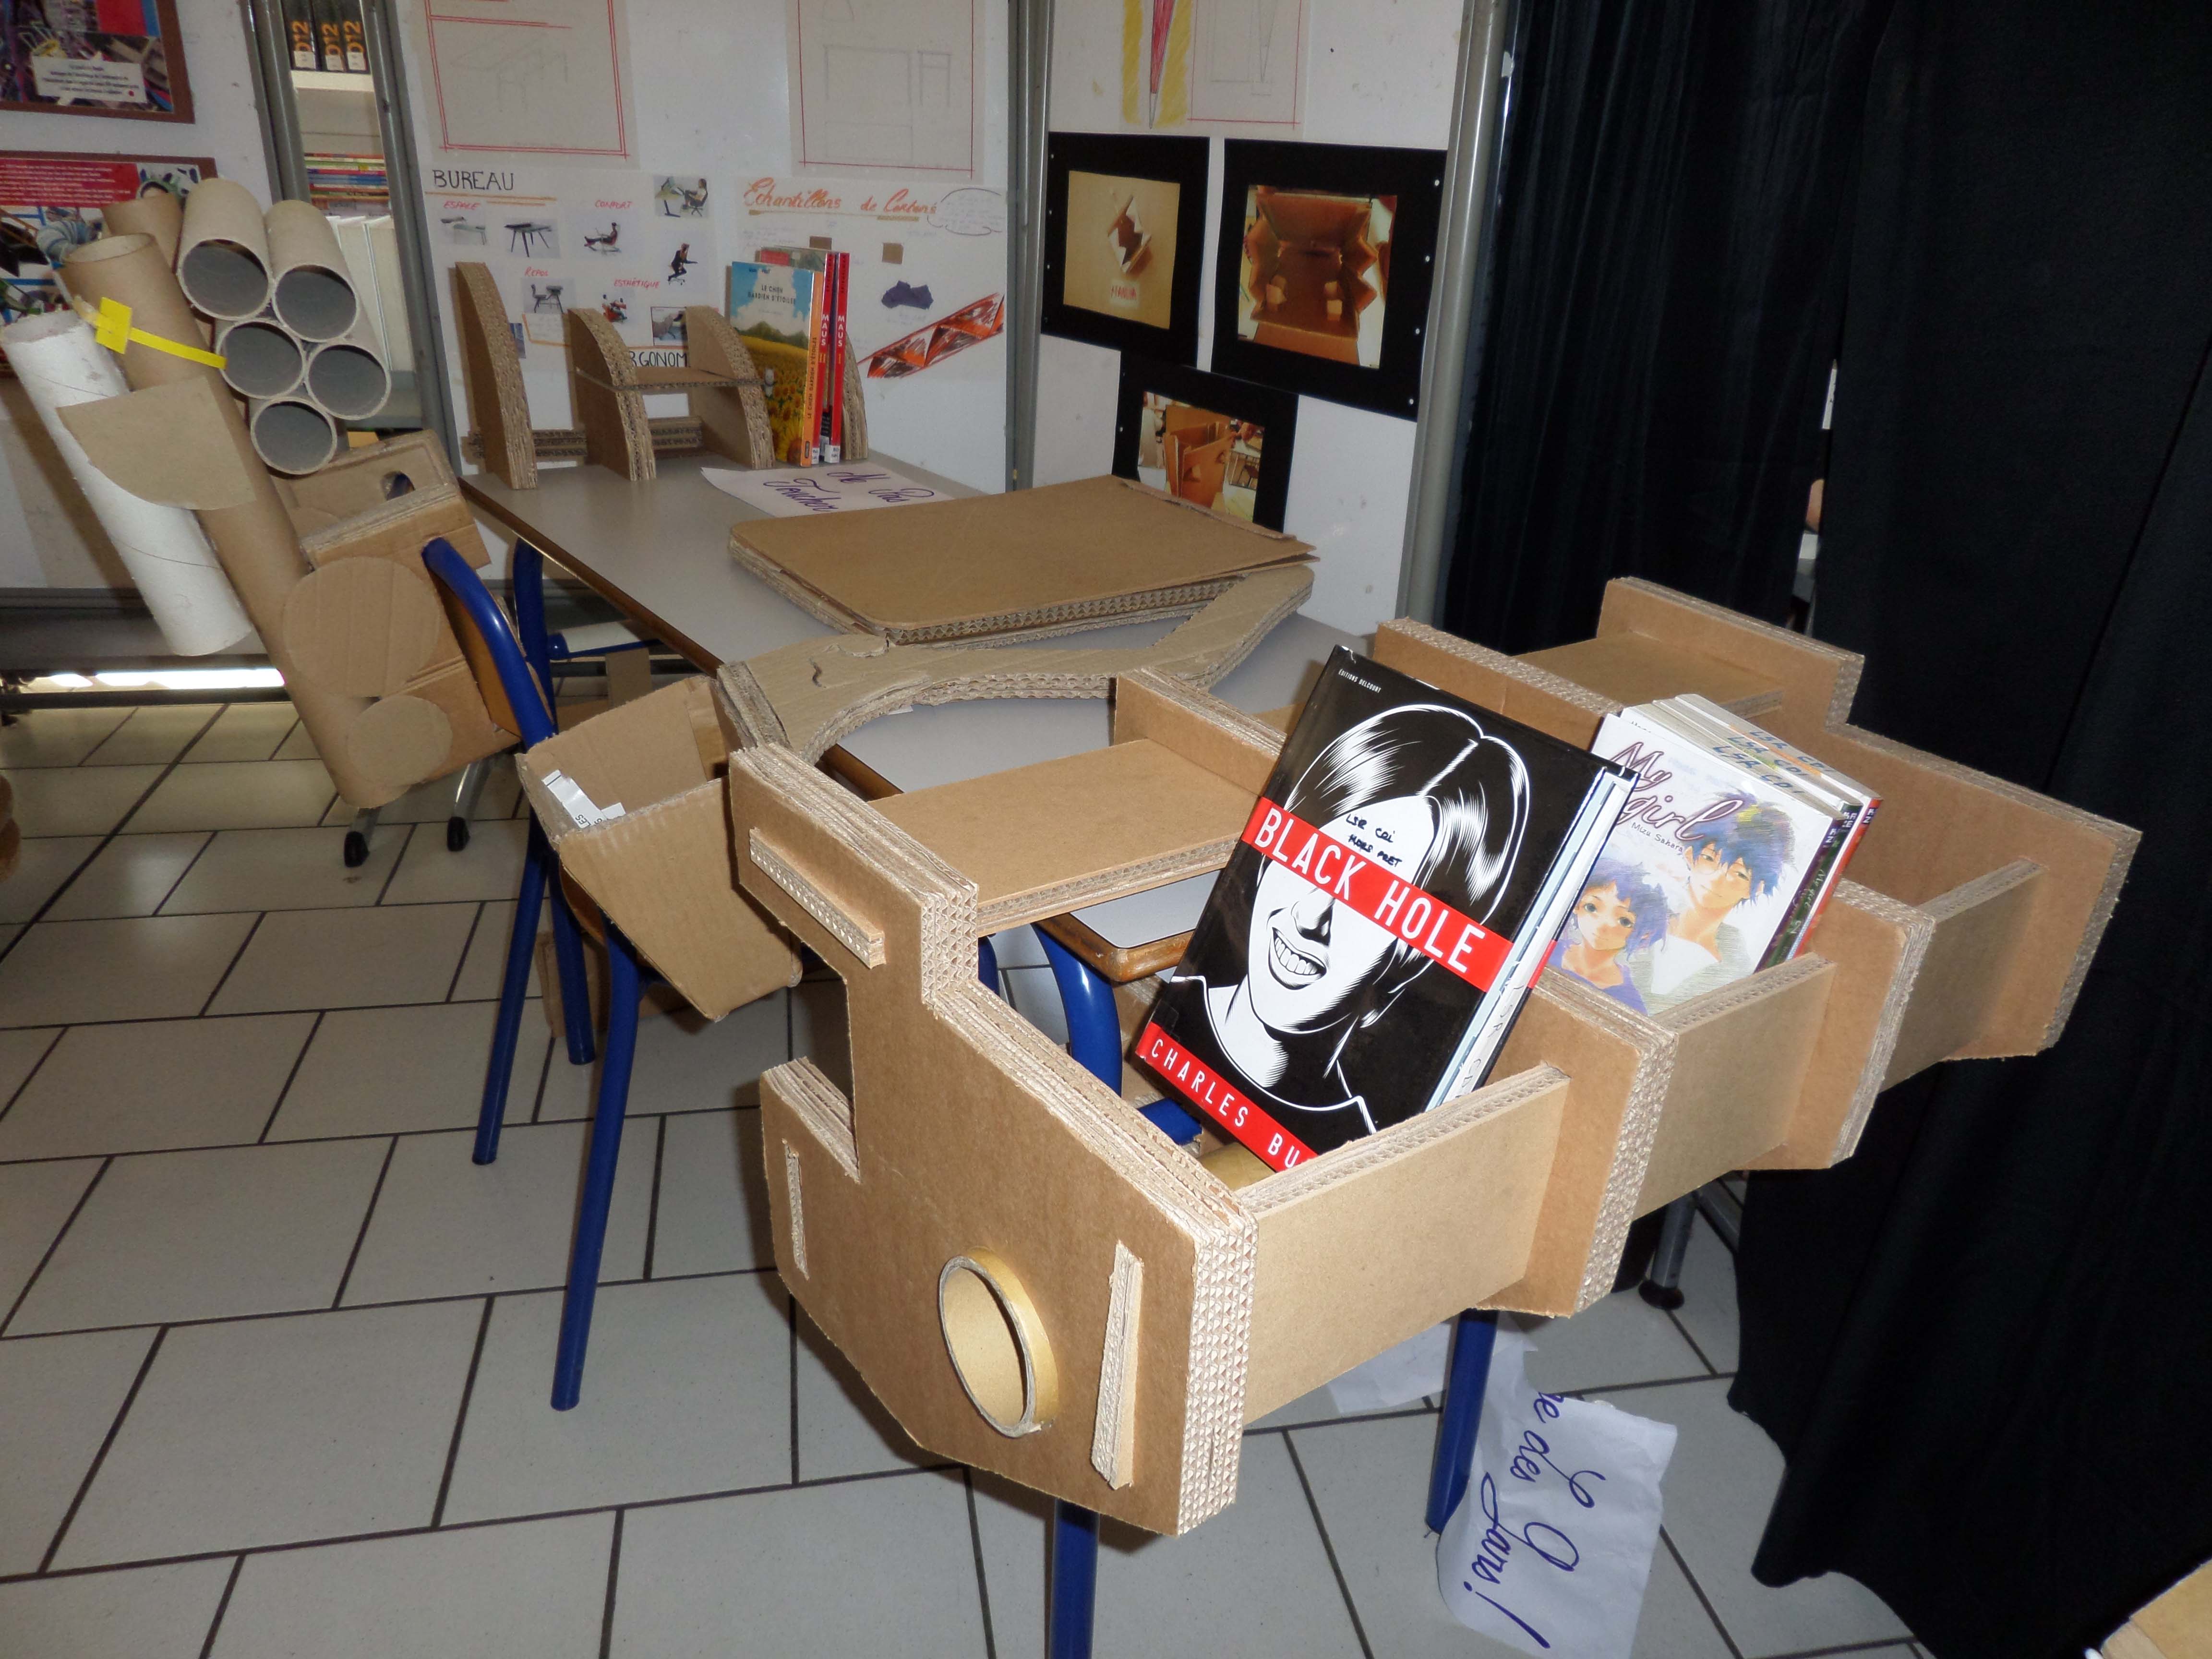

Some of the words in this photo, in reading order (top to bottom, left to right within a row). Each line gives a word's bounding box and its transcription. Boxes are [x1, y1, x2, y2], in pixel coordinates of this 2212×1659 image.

[433, 169, 513, 191] BUREAU
[821, 313, 830, 346] MAUS
[868, 488, 935, 503] Pas
[1358, 679, 1382, 693] DELCOURT
[1610, 742, 1672, 792] My
[1616, 795, 1743, 841] girl
[1631, 822, 1651, 837] Mizu
[1654, 833, 1684, 853] Sahara
[1377, 850, 1403, 867] PRET
[1254, 807, 1367, 901] BLACK
[1373, 879, 1486, 974] HOLE
[1152, 1039, 1249, 1127] CHARLES
[1510, 1430, 1606, 1509] des
